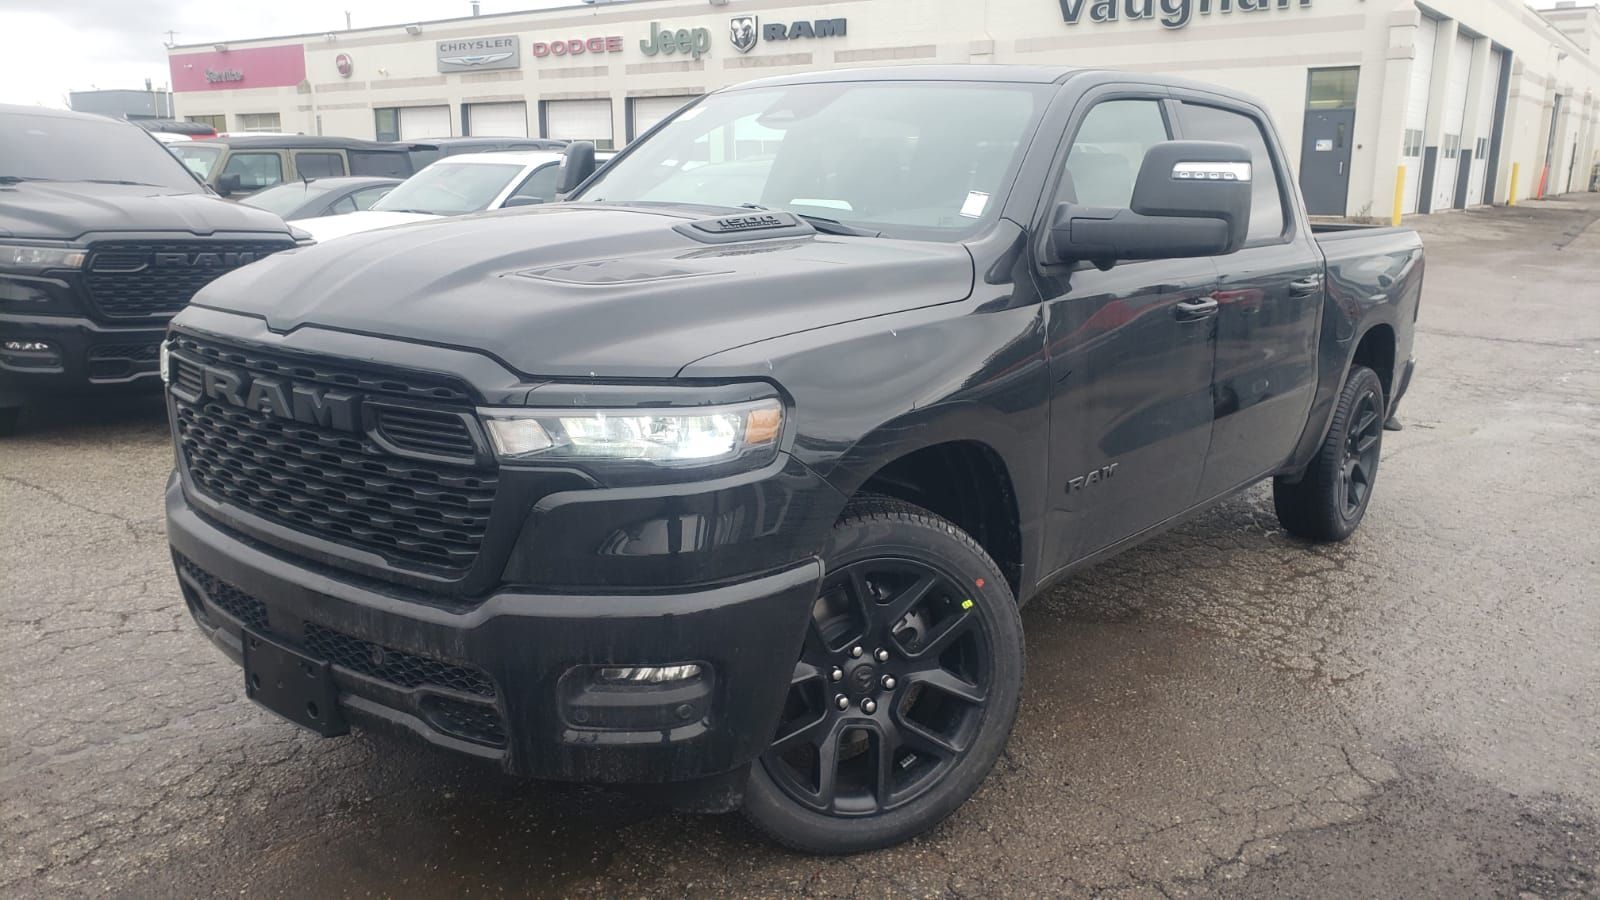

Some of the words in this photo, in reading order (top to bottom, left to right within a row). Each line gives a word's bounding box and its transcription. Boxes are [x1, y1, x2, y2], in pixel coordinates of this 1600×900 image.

[639, 22, 712, 60] Jeep
[763, 18, 847, 41] RAM
[439, 38, 514, 53] CHRYSLER
[532, 36, 624, 57] DODGE
[155, 252, 255, 267] RAM
[204, 365, 356, 432] RAM
[1065, 462, 1119, 495] RAM
